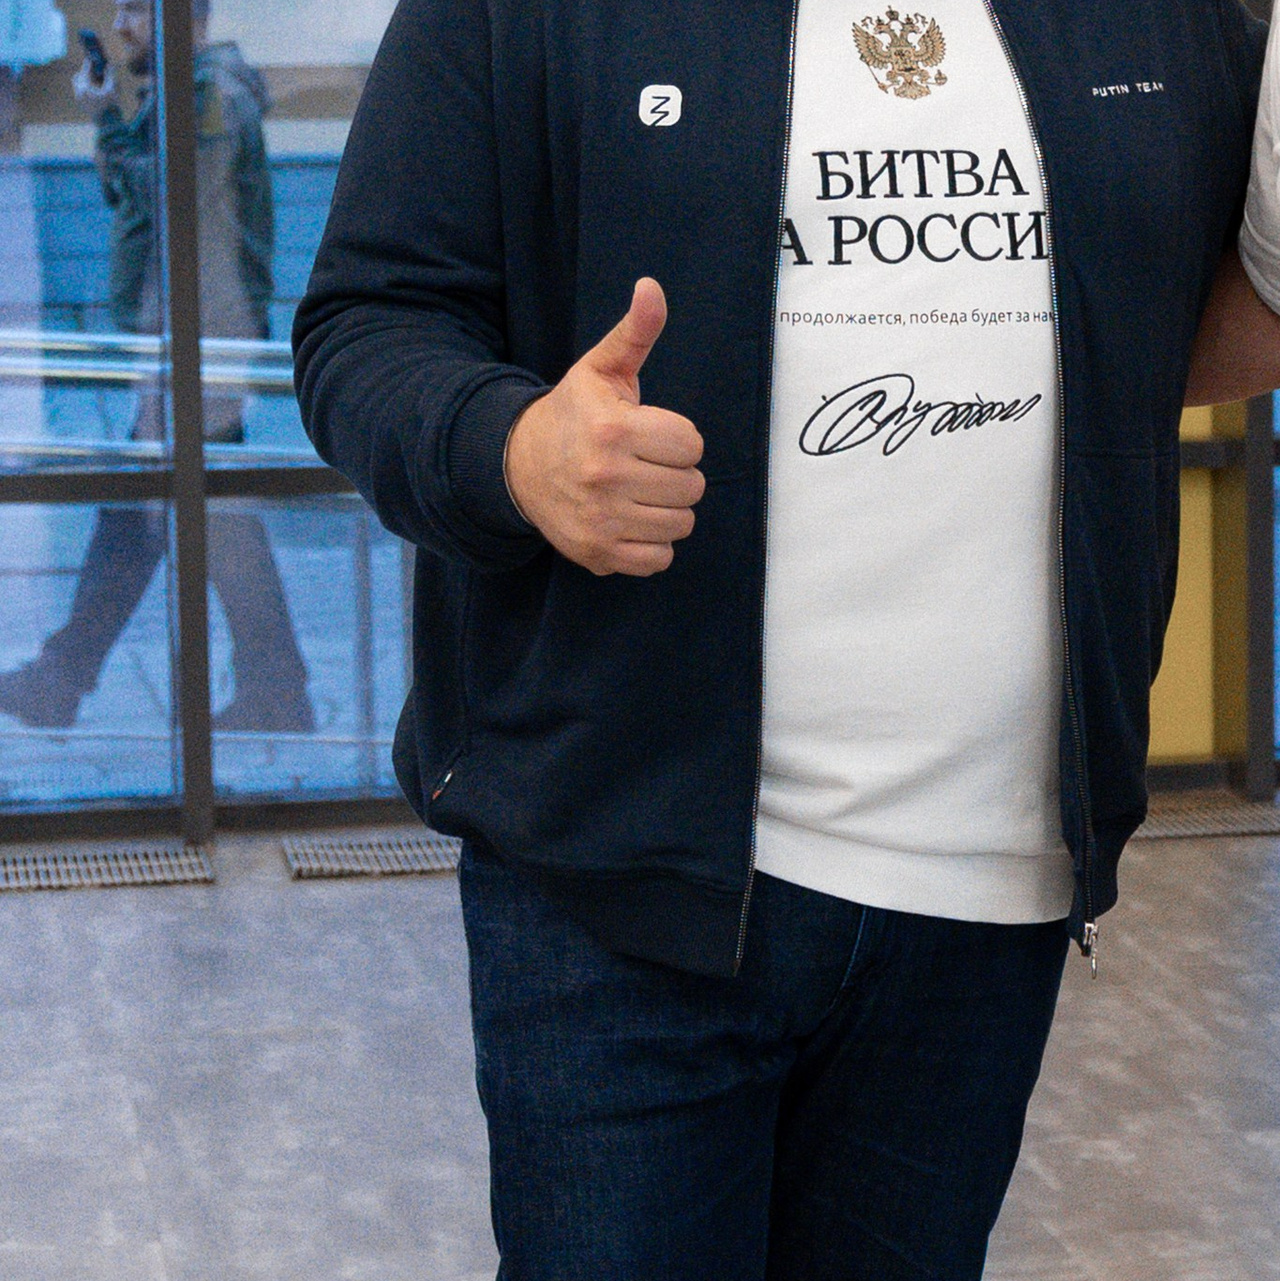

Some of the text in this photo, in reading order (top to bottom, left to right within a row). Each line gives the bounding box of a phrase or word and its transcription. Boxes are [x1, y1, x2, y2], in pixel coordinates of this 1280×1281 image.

[1091, 84, 1130, 98] PUTIN
[811, 148, 1031, 201] БИТВА
[780, 311, 907, 326] продолжается,
[909, 308, 968, 325] победа
[971, 307, 1012, 327] будет
[1015, 310, 1030, 323] за
